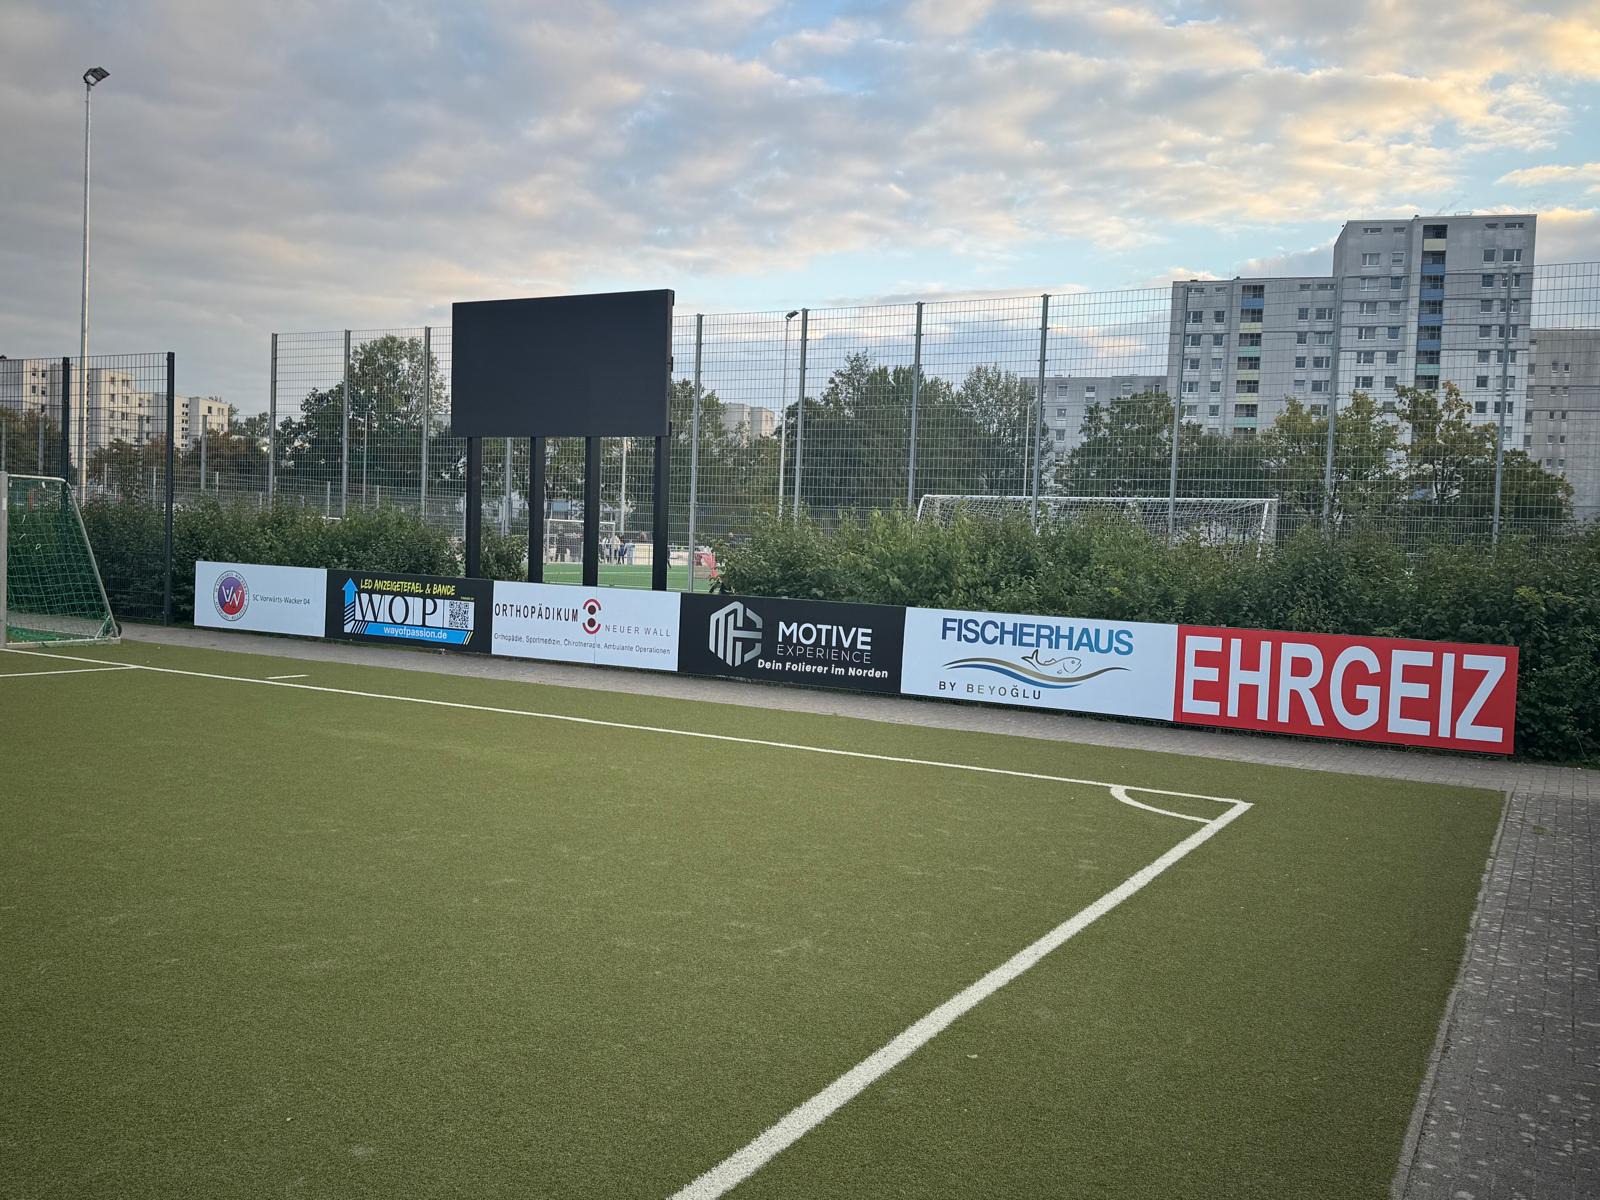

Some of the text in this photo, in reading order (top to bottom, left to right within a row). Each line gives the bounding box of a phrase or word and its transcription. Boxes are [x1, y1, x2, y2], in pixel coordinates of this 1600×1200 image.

[252, 593, 260, 602] SC
[360, 579, 373, 590] LED
[425, 584, 431, 594] &
[432, 584, 456, 596] BANDE
[355, 593, 438, 627] WOP
[494, 603, 579, 622] ORTHOPÄDIKUM
[383, 626, 447, 640] wayofpassion.de
[605, 624, 671, 637] NEUER WALL
[778, 621, 873, 650] MOTIVE
[941, 617, 1134, 656] FISCHERHAUS
[603, 642, 634, 652] Ambulante
[635, 644, 671, 655] Operationen
[777, 644, 871, 664] EXPERIENCE
[757, 659, 889, 679] Dein Folierer im Norden
[938, 680, 1041, 700] BY BEYOĞLU
[1182, 635, 1507, 743] EHRGEIZ
